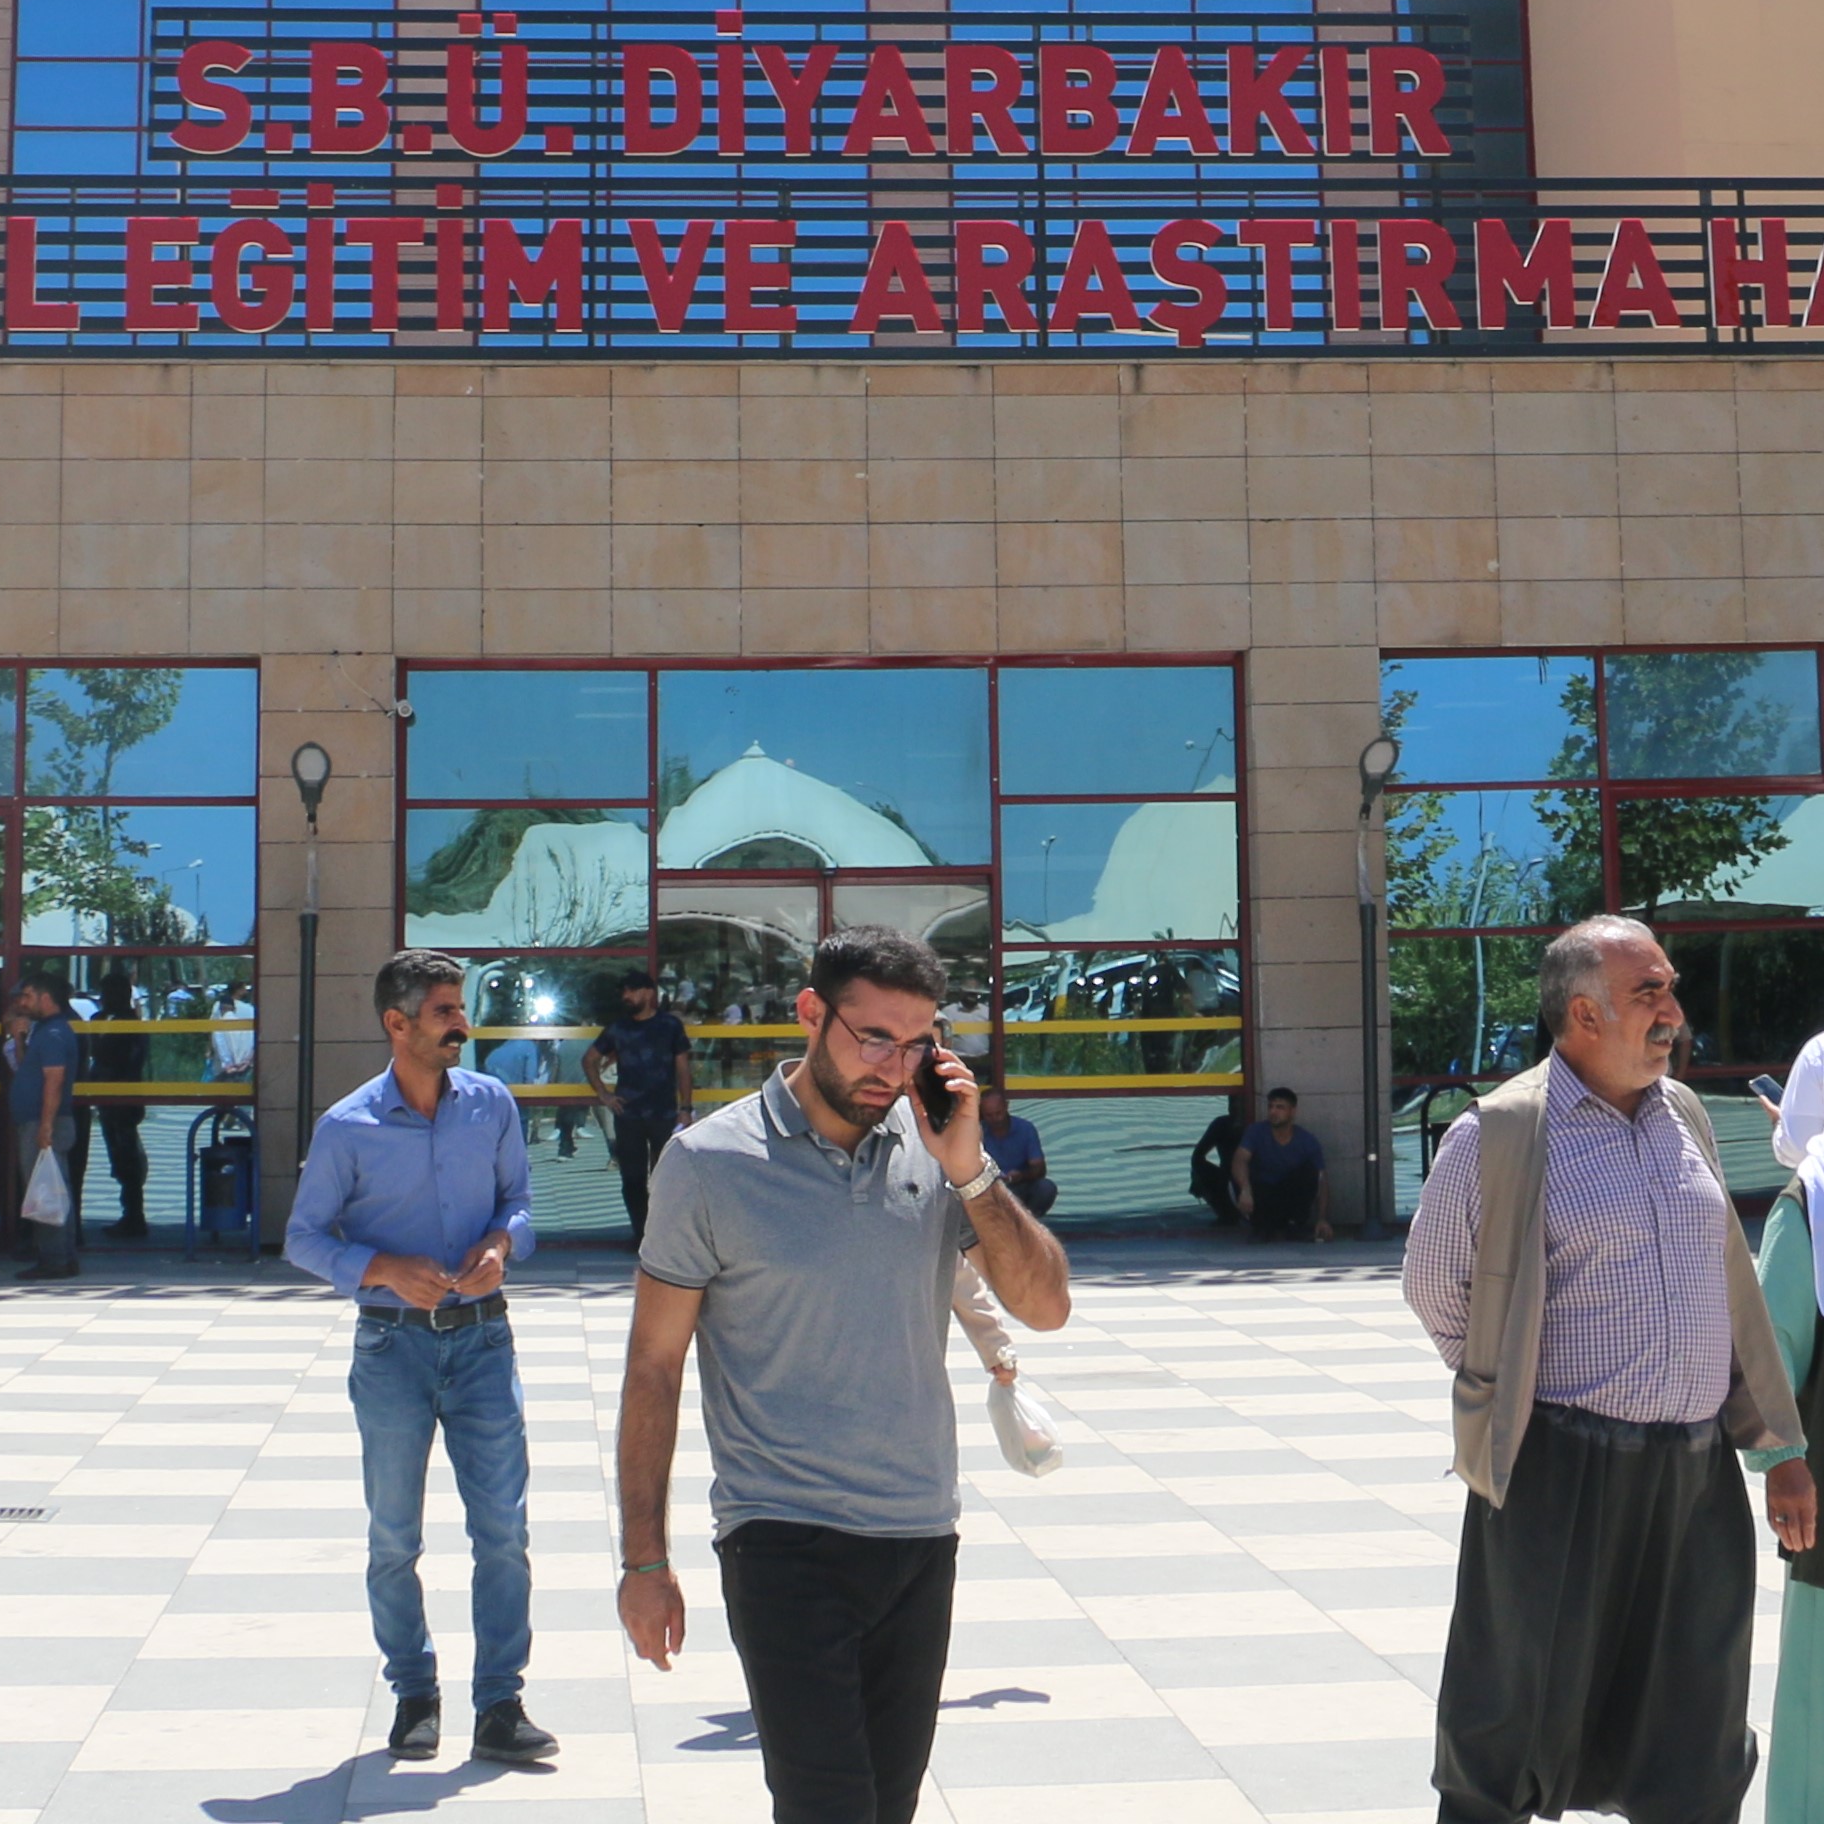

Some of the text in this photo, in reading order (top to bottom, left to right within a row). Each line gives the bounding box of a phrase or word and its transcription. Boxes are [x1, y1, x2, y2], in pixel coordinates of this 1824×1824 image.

[169, 9, 1451, 158] S.B.Ü. DİYARBAKIR
[125, 181, 583, 334] EĞİTİM
[626, 219, 798, 335] VE
[848, 217, 1681, 348] ARAŞTIRMA
